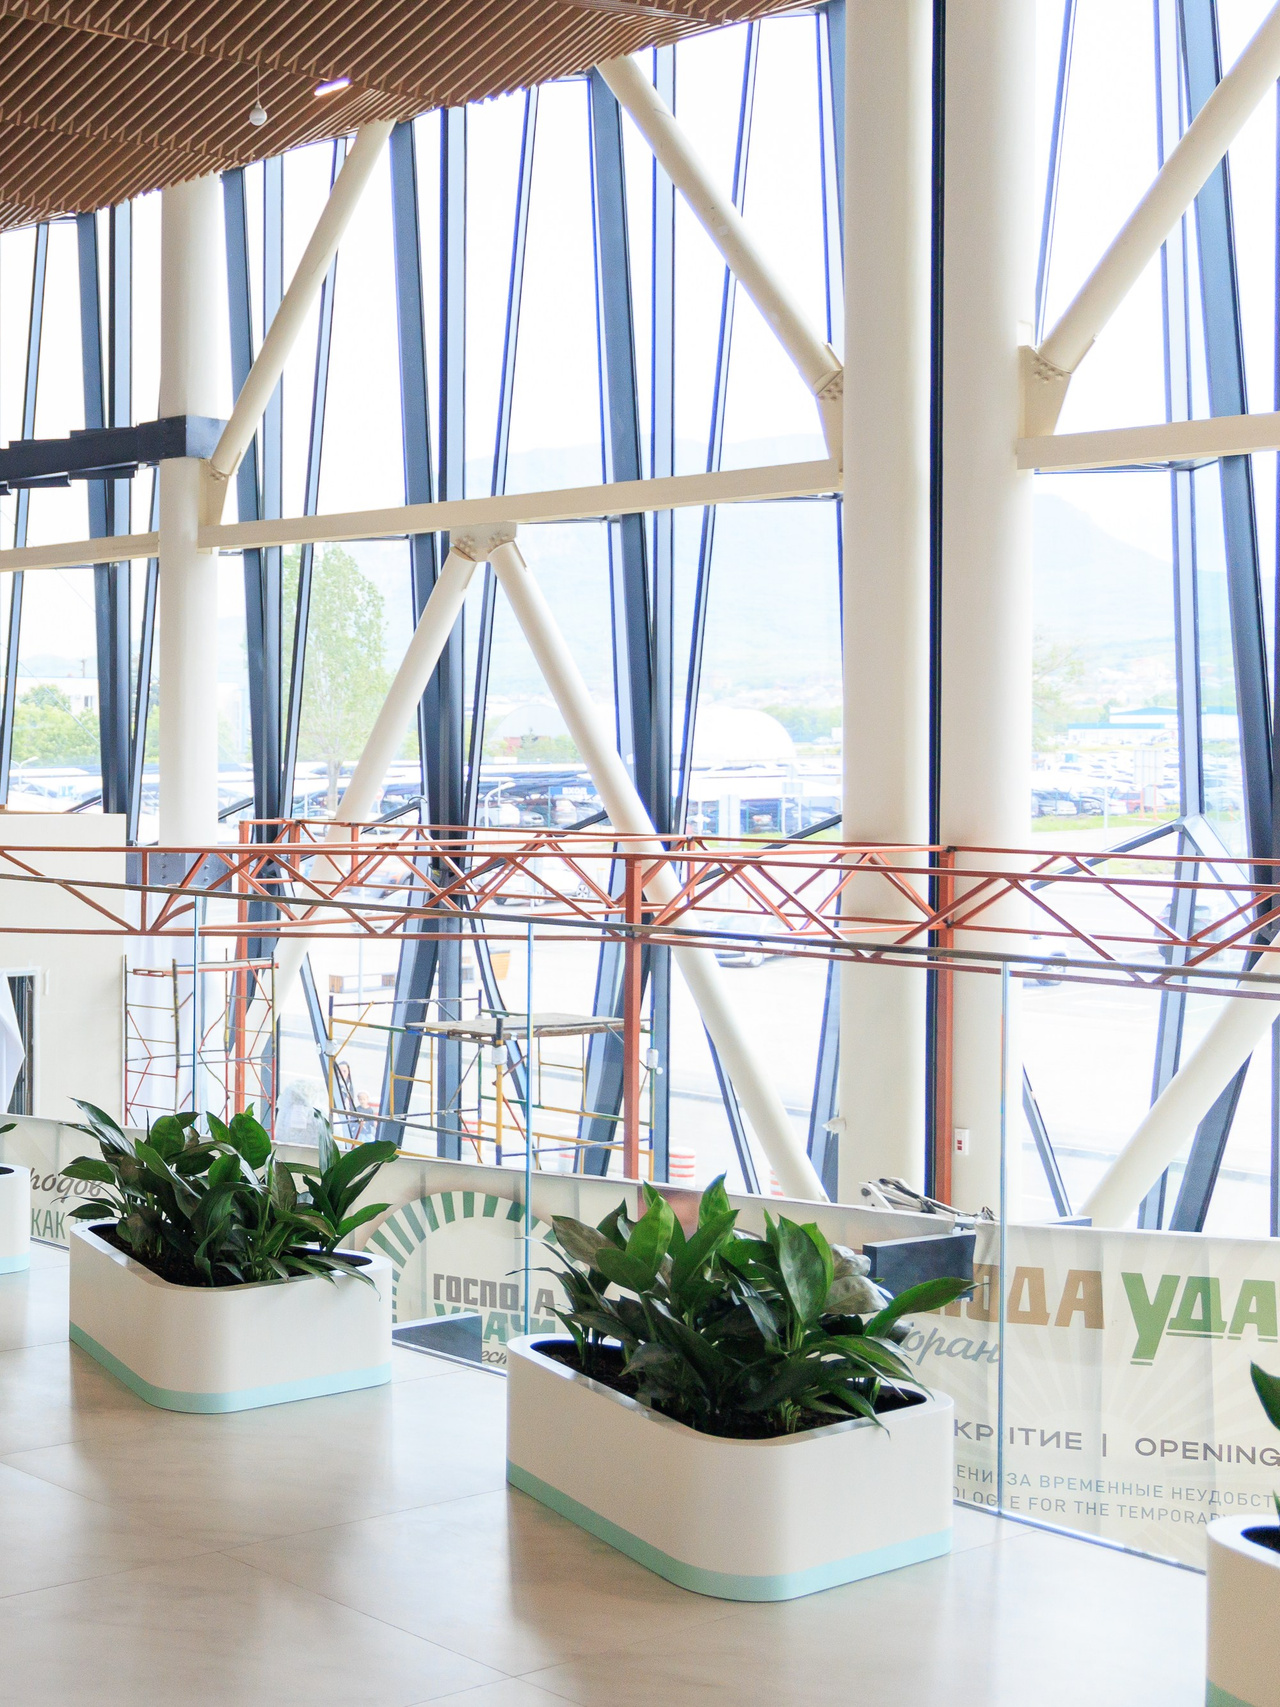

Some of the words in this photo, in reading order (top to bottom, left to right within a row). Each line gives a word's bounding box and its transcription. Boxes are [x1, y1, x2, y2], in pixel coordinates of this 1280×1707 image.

[433, 1273, 556, 1318] ГОСПОА
[1121, 1271, 1280, 1361] УДА
[1135, 1436, 1280, 1468] OPENING
[1006, 1472, 1032, 1487] ЗА
[1039, 1474, 1163, 1499] ВРЕМЕННЫЕ
[1171, 1486, 1280, 1508] НЕУДОБСТ
[1028, 1496, 1066, 1513] FOR
[1074, 1500, 1110, 1517] THE
